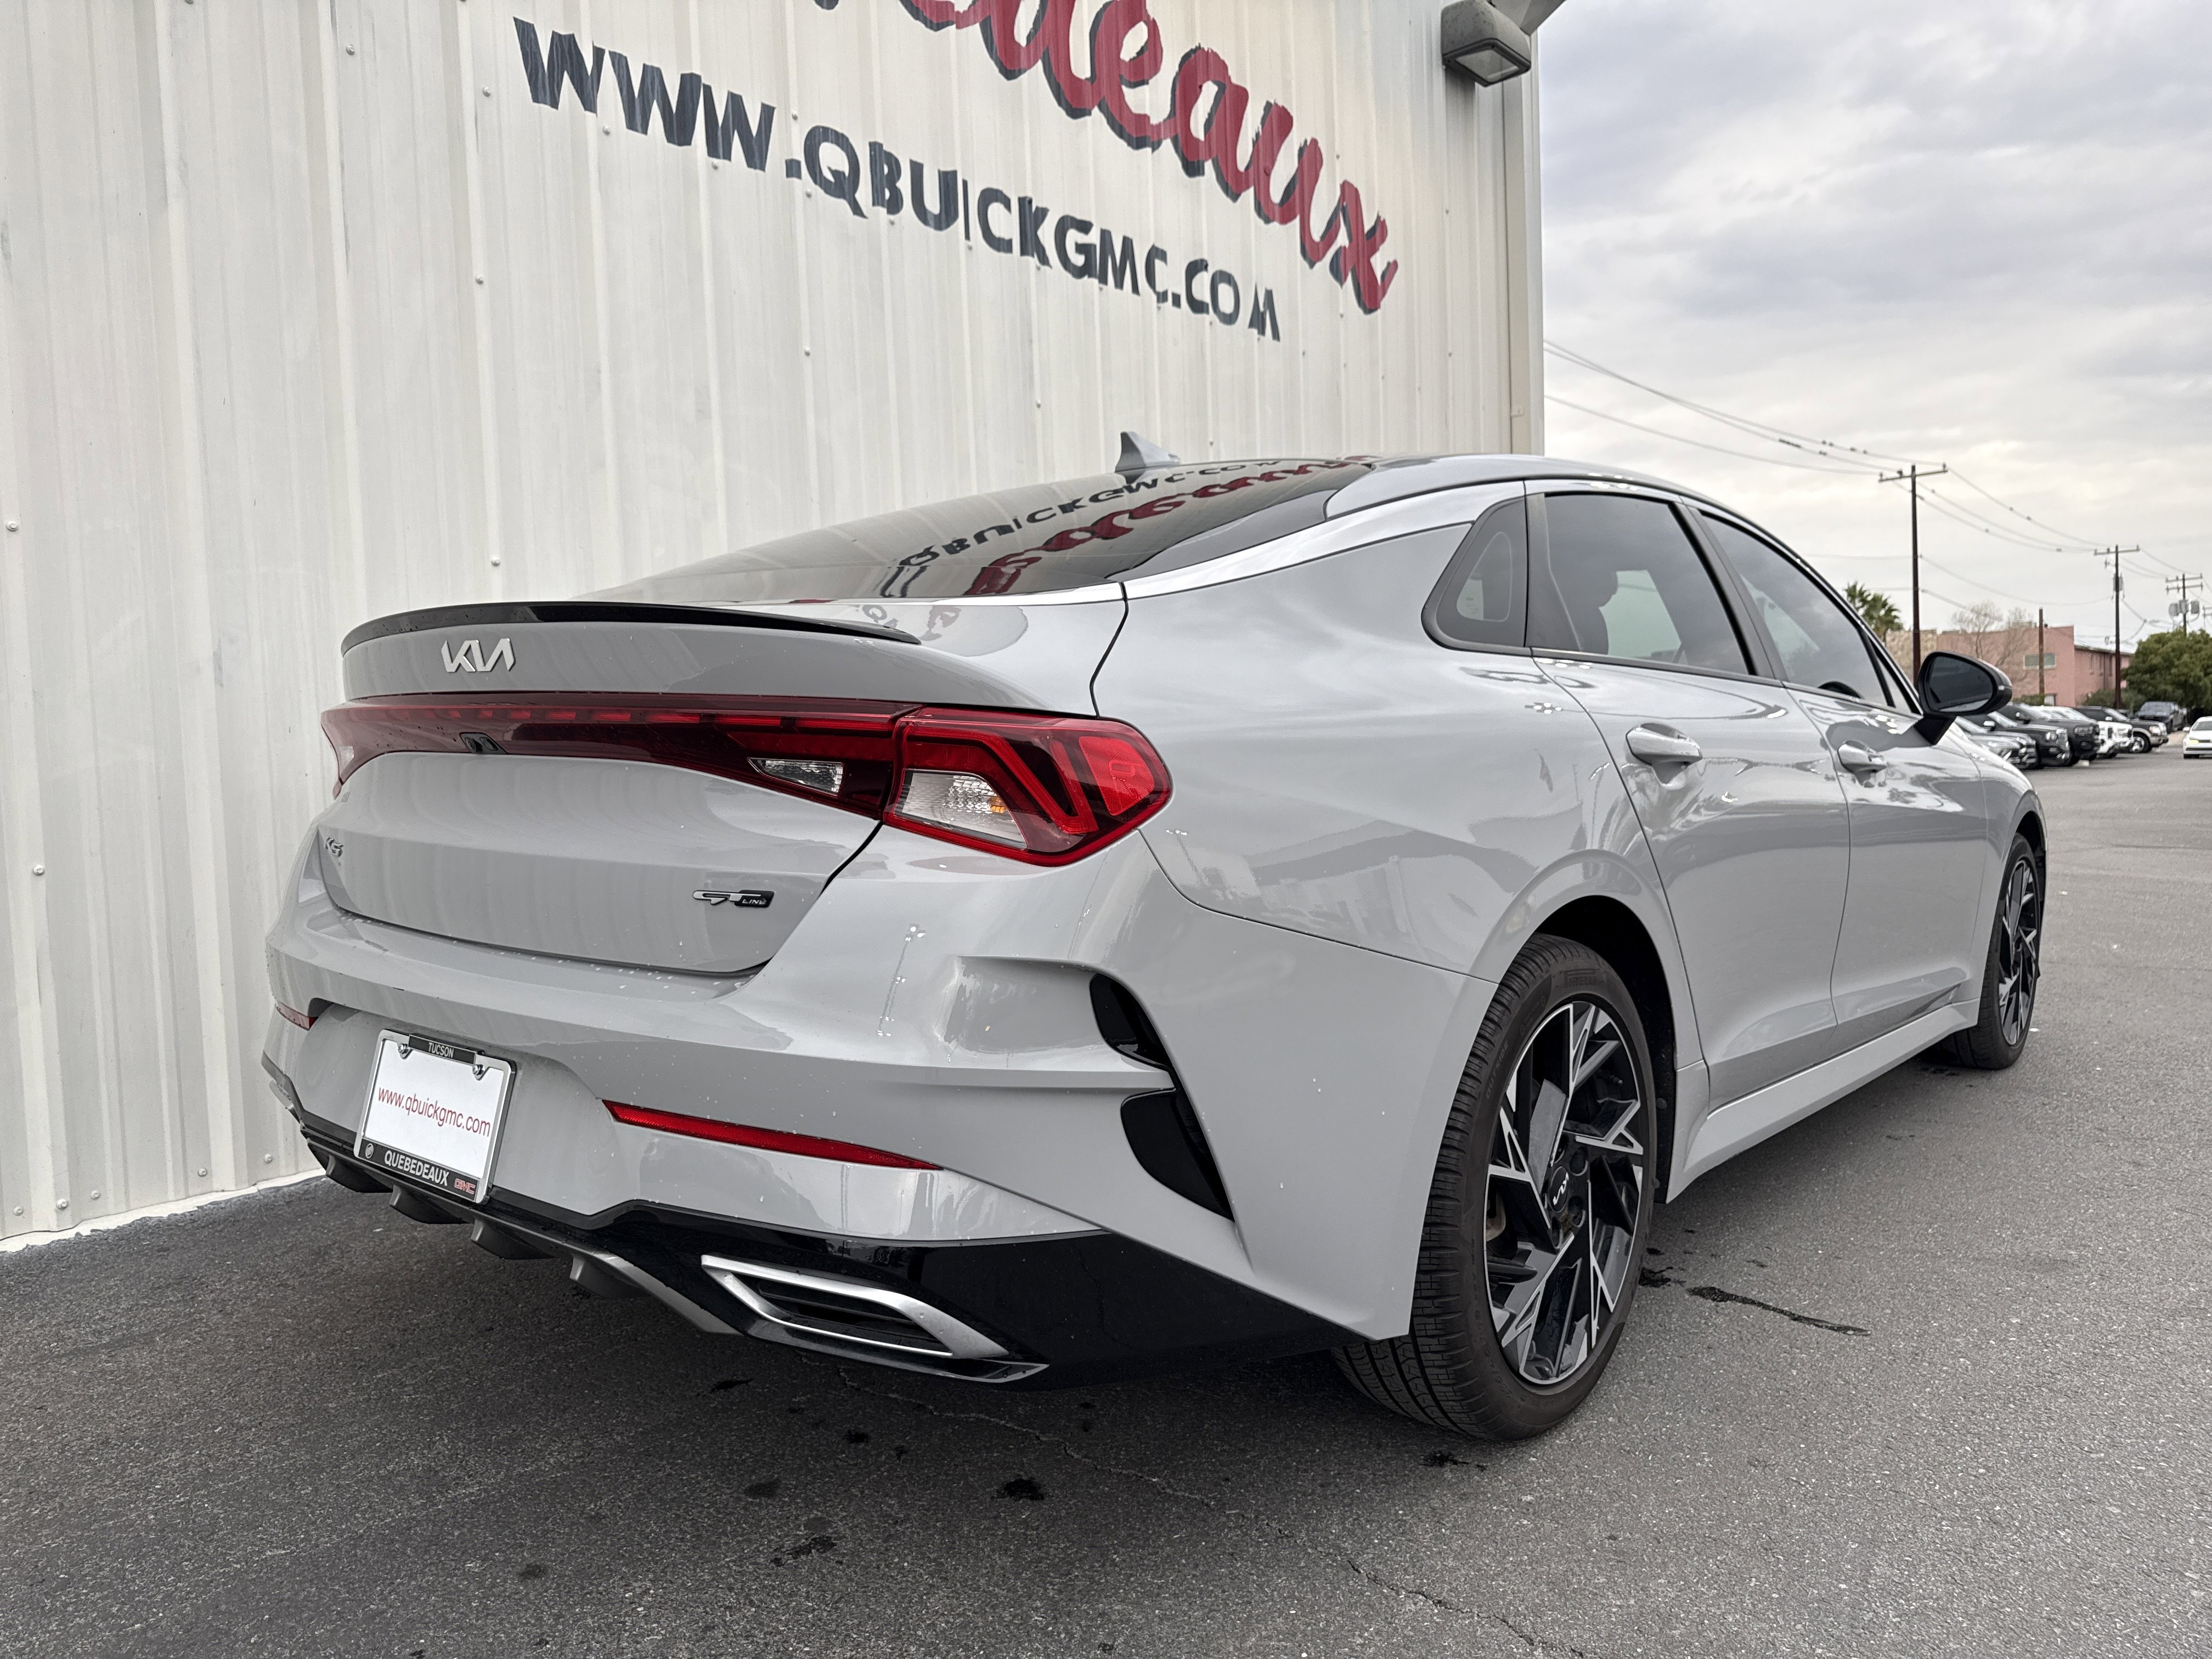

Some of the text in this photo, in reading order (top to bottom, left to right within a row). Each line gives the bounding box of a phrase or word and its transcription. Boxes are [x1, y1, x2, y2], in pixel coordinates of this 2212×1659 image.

[513, 17, 1280, 341] WWW.QBUICKGMC.COM
[441, 638, 516, 673] KIA
[428, 1042, 454, 1058] TUCSON
[379, 1087, 491, 1137] www.qbuickgmc.com
[384, 1150, 476, 1195] QUEBEDEAUX GMC
